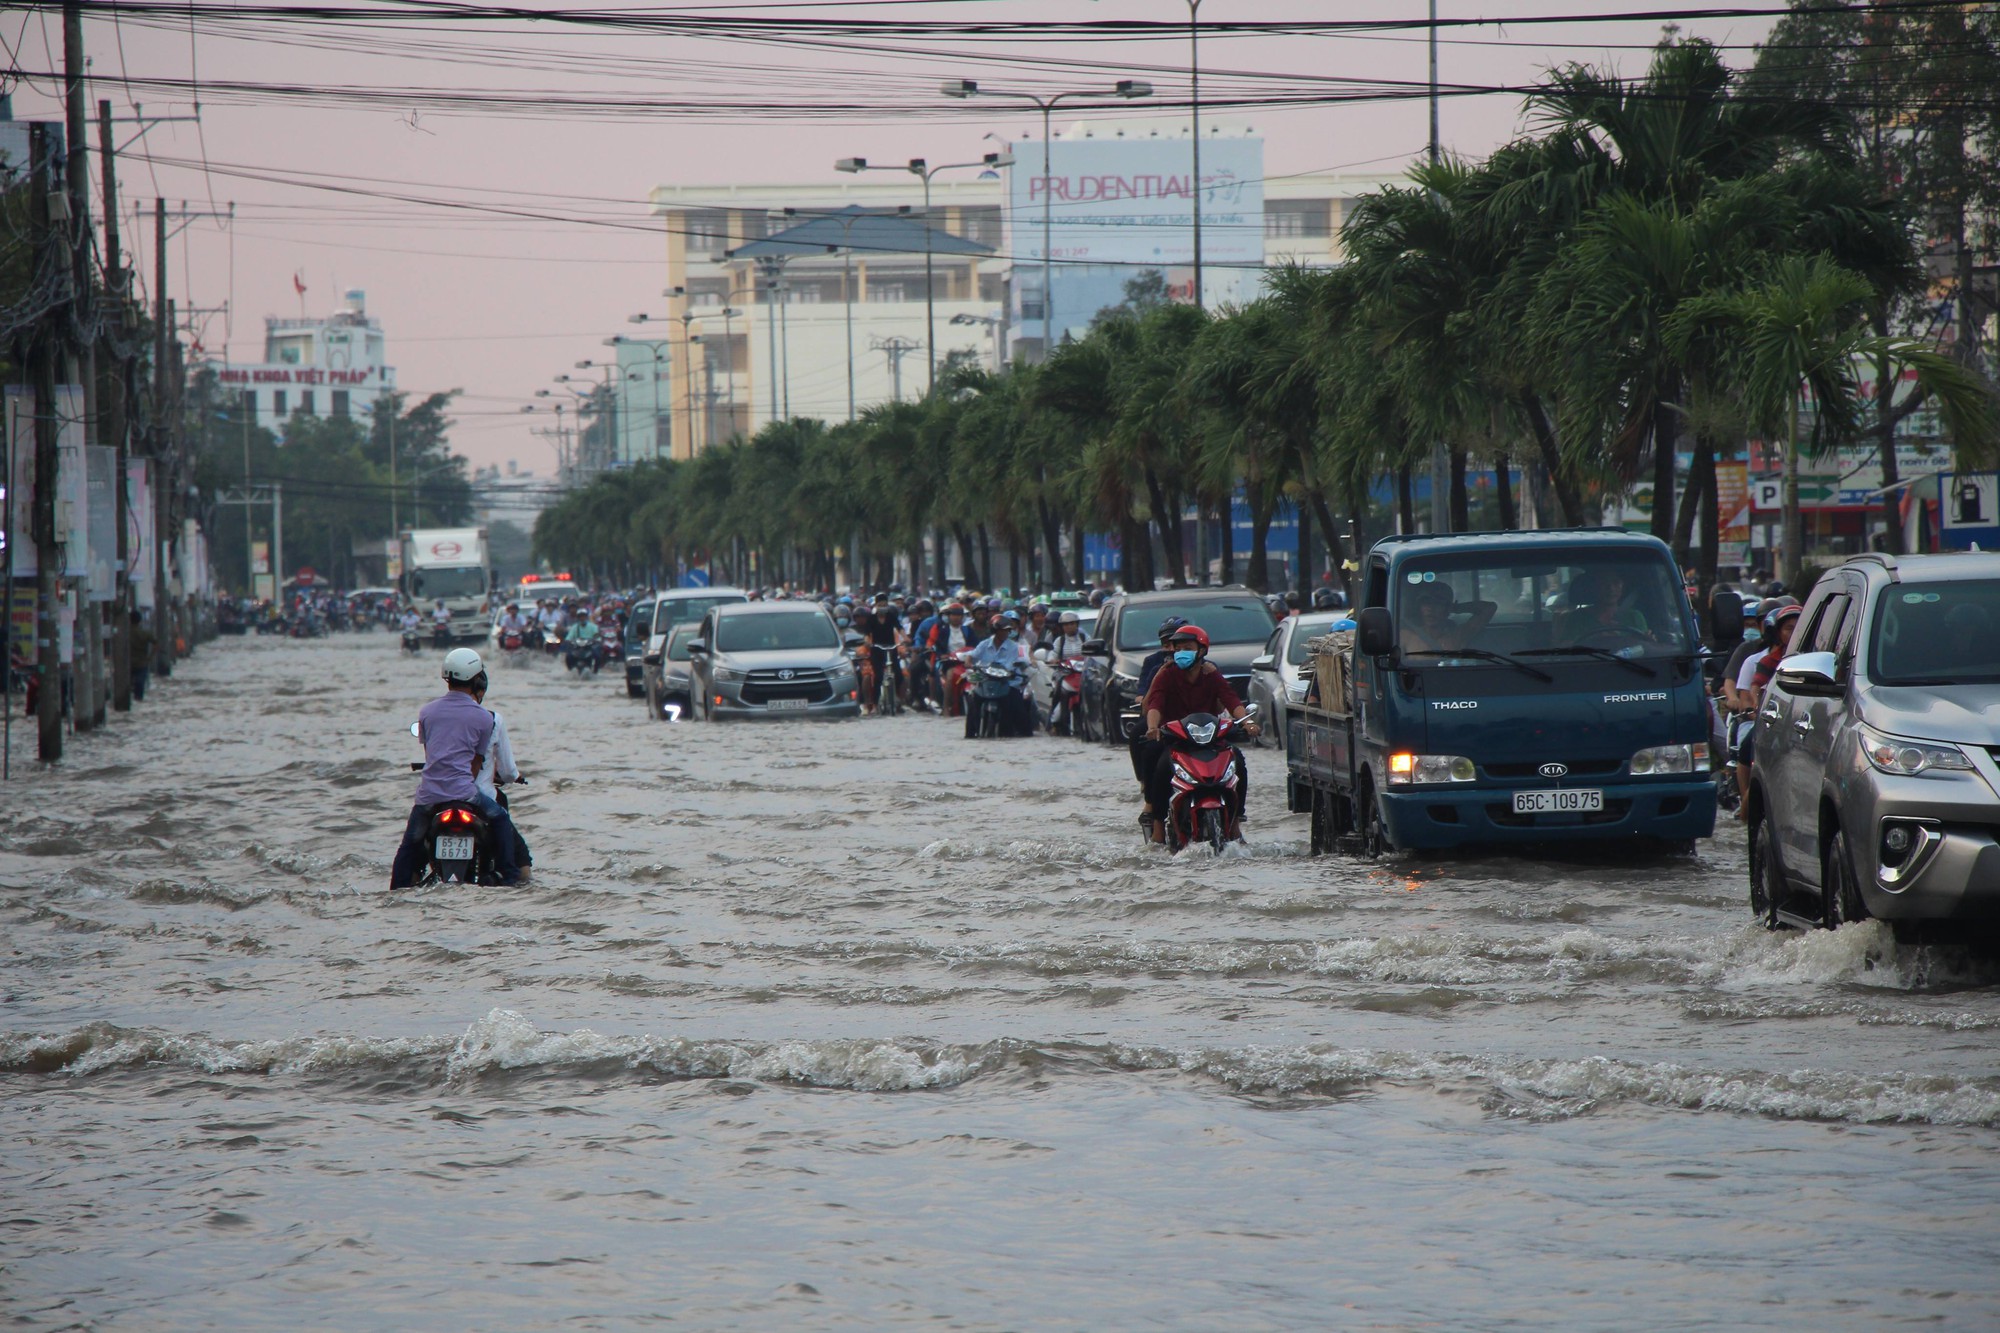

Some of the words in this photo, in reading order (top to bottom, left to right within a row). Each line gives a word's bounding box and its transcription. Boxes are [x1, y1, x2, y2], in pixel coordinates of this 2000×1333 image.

[1029, 175, 1195, 201] PRUDENTIAL
[219, 369, 249, 383] NHA
[252, 369, 291, 383] KHOA
[295, 367, 324, 385] VIỆT
[328, 368, 367, 384] PHÁP
[1763, 486, 1776, 504] P
[1603, 692, 1667, 704] FRONTIER
[1431, 700, 1478, 709] THACO
[1542, 765, 1564, 775] KIA
[1515, 792, 1600, 811] 65C-109.75
[442, 838, 468, 847] 65-Z1
[441, 848, 468, 858] 6679
